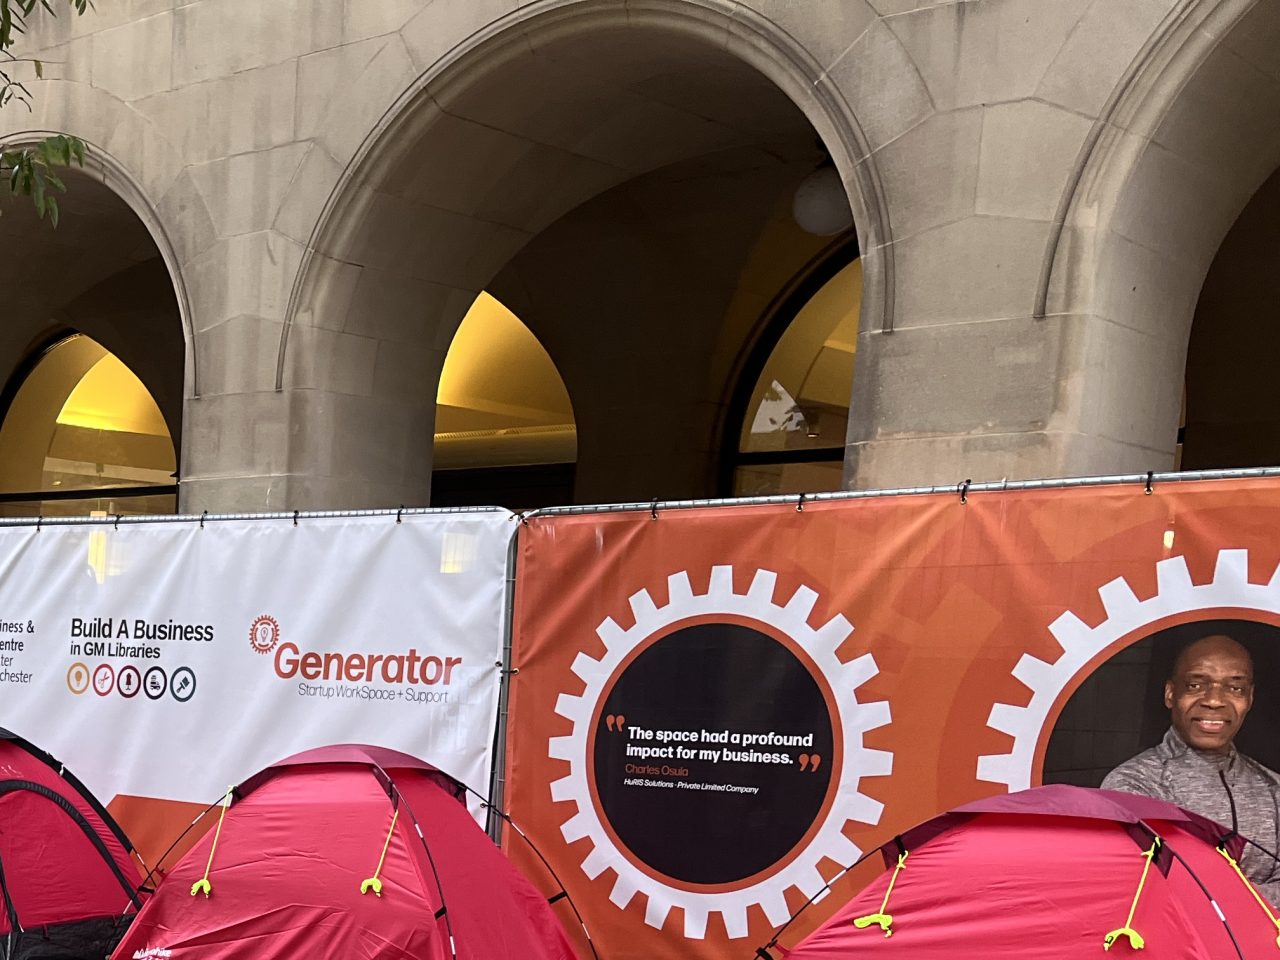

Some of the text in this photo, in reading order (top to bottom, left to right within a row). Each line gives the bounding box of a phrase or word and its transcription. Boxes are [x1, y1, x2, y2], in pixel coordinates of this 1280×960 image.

[26, 619, 35, 633] &
[70, 618, 214, 642] Build A Business
[70, 641, 161, 659] in GM Libraries
[274, 642, 463, 685] Generator
[298, 683, 335, 700] Startup
[336, 684, 396, 700] WorkSpace
[405, 688, 449, 704] Support
[628, 726, 813, 748] The space had a profound
[626, 743, 794, 765] impact for my business.
[625, 763, 660, 776] Charles
[644, 779, 674, 789] Solutions
[677, 781, 701, 790] Private
[701, 782, 725, 792] Limited
[725, 784, 760, 795] Company
